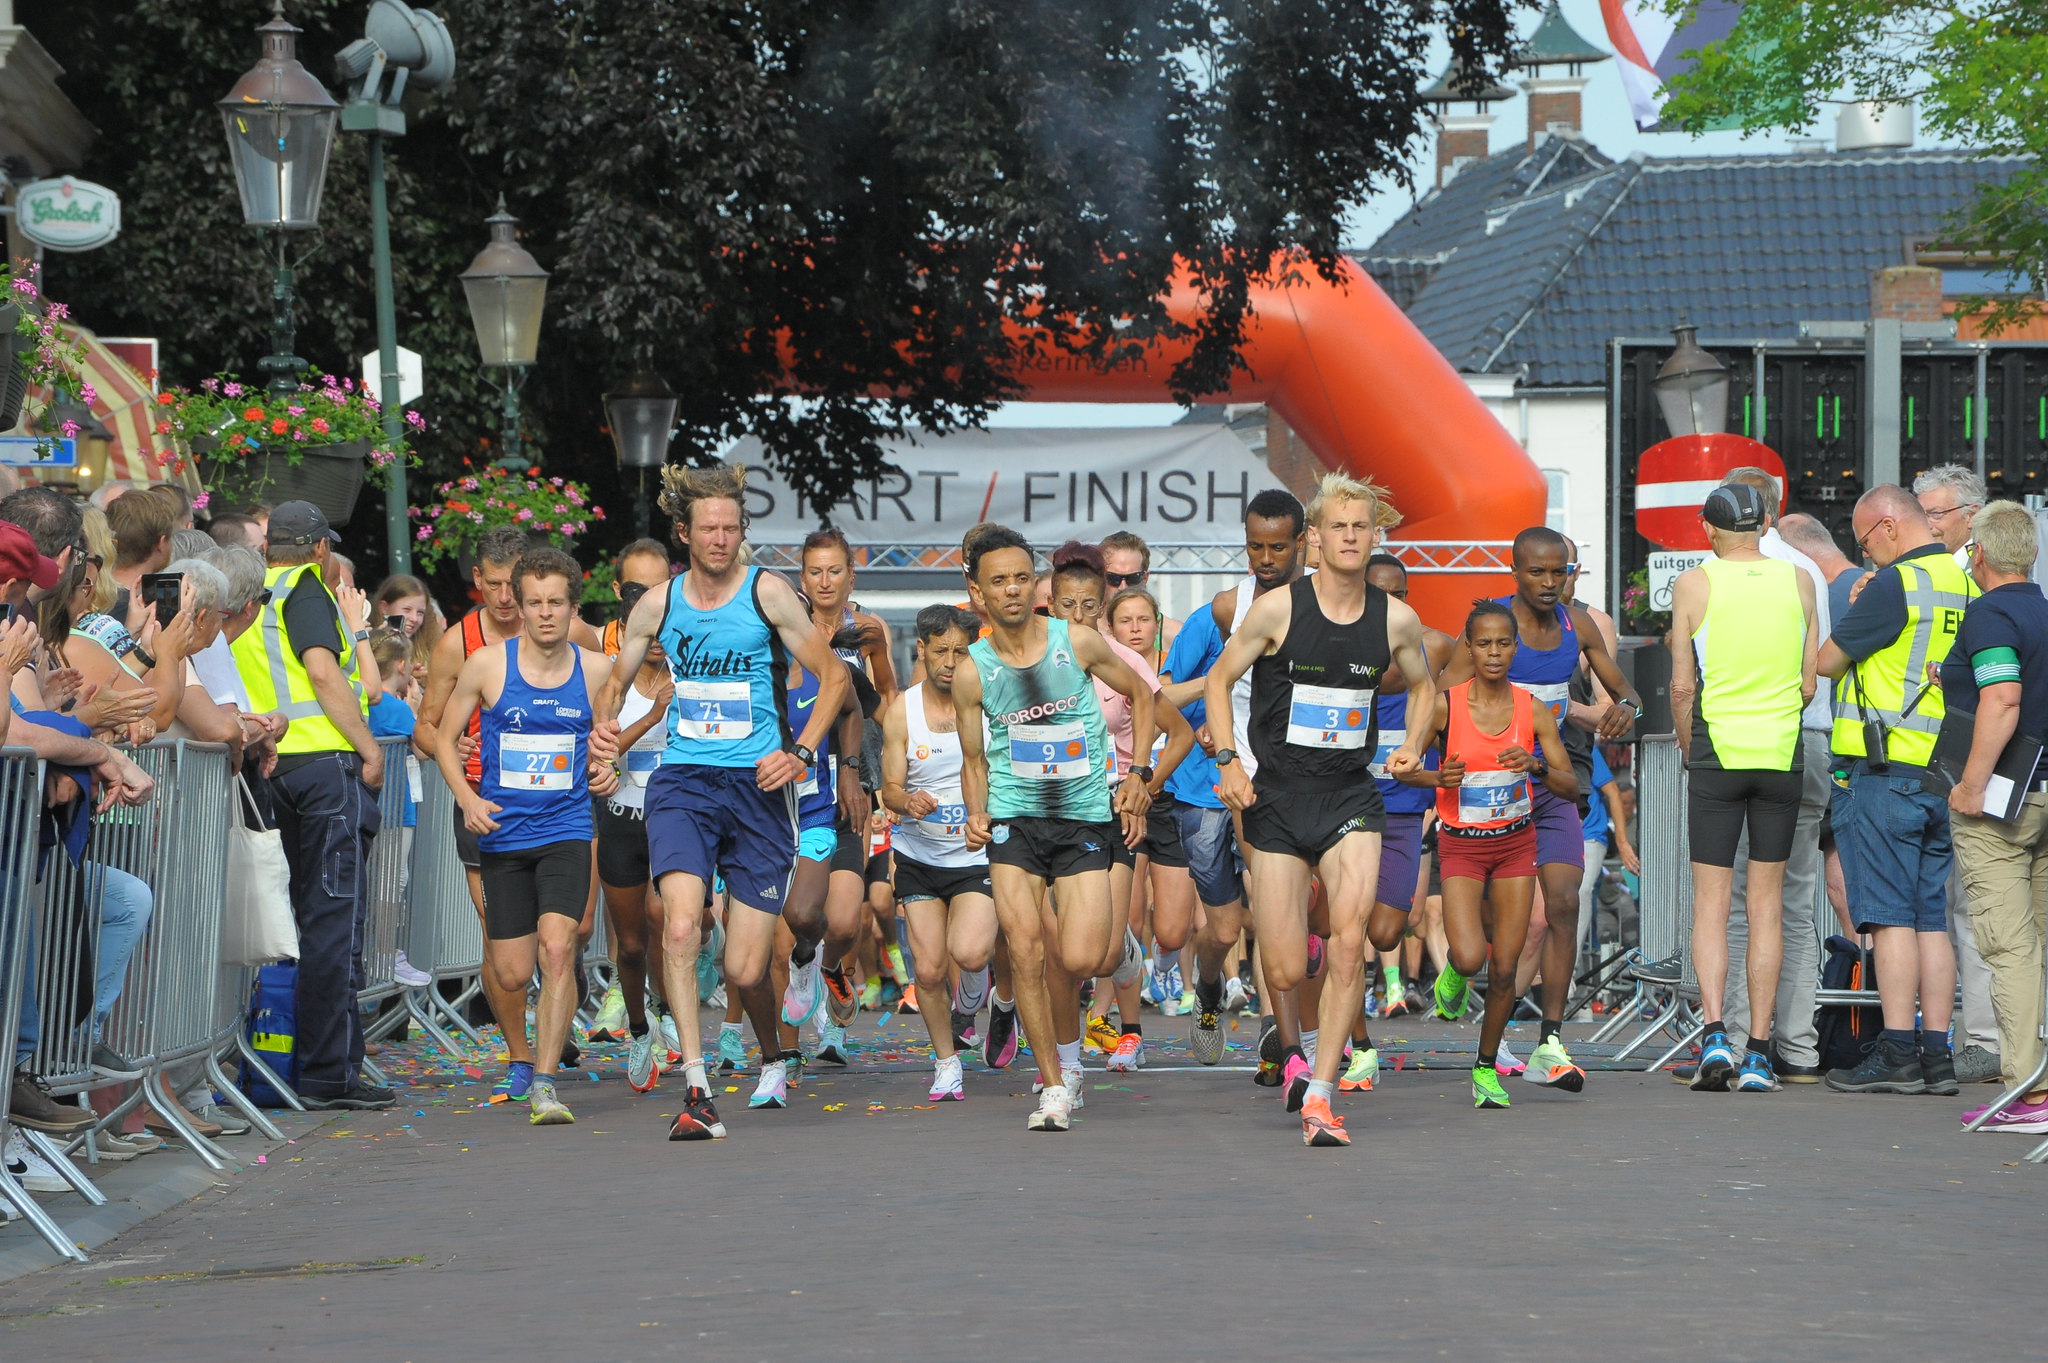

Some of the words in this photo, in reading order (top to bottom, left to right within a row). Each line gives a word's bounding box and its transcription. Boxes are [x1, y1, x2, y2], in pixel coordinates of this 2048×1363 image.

[31, 197, 103, 225] Grolsch
[1023, 469, 1249, 523] FINISH
[672, 627, 752, 679] Vitalis
[1349, 663, 1380, 678] RUNX
[699, 702, 725, 720] 71
[996, 695, 1079, 726] MOROCCO
[1325, 708, 1339, 728] 3
[1042, 743, 1056, 762] 9
[526, 753, 551, 772] 27
[1486, 788, 1510, 806] 14
[940, 806, 965, 824] 59
